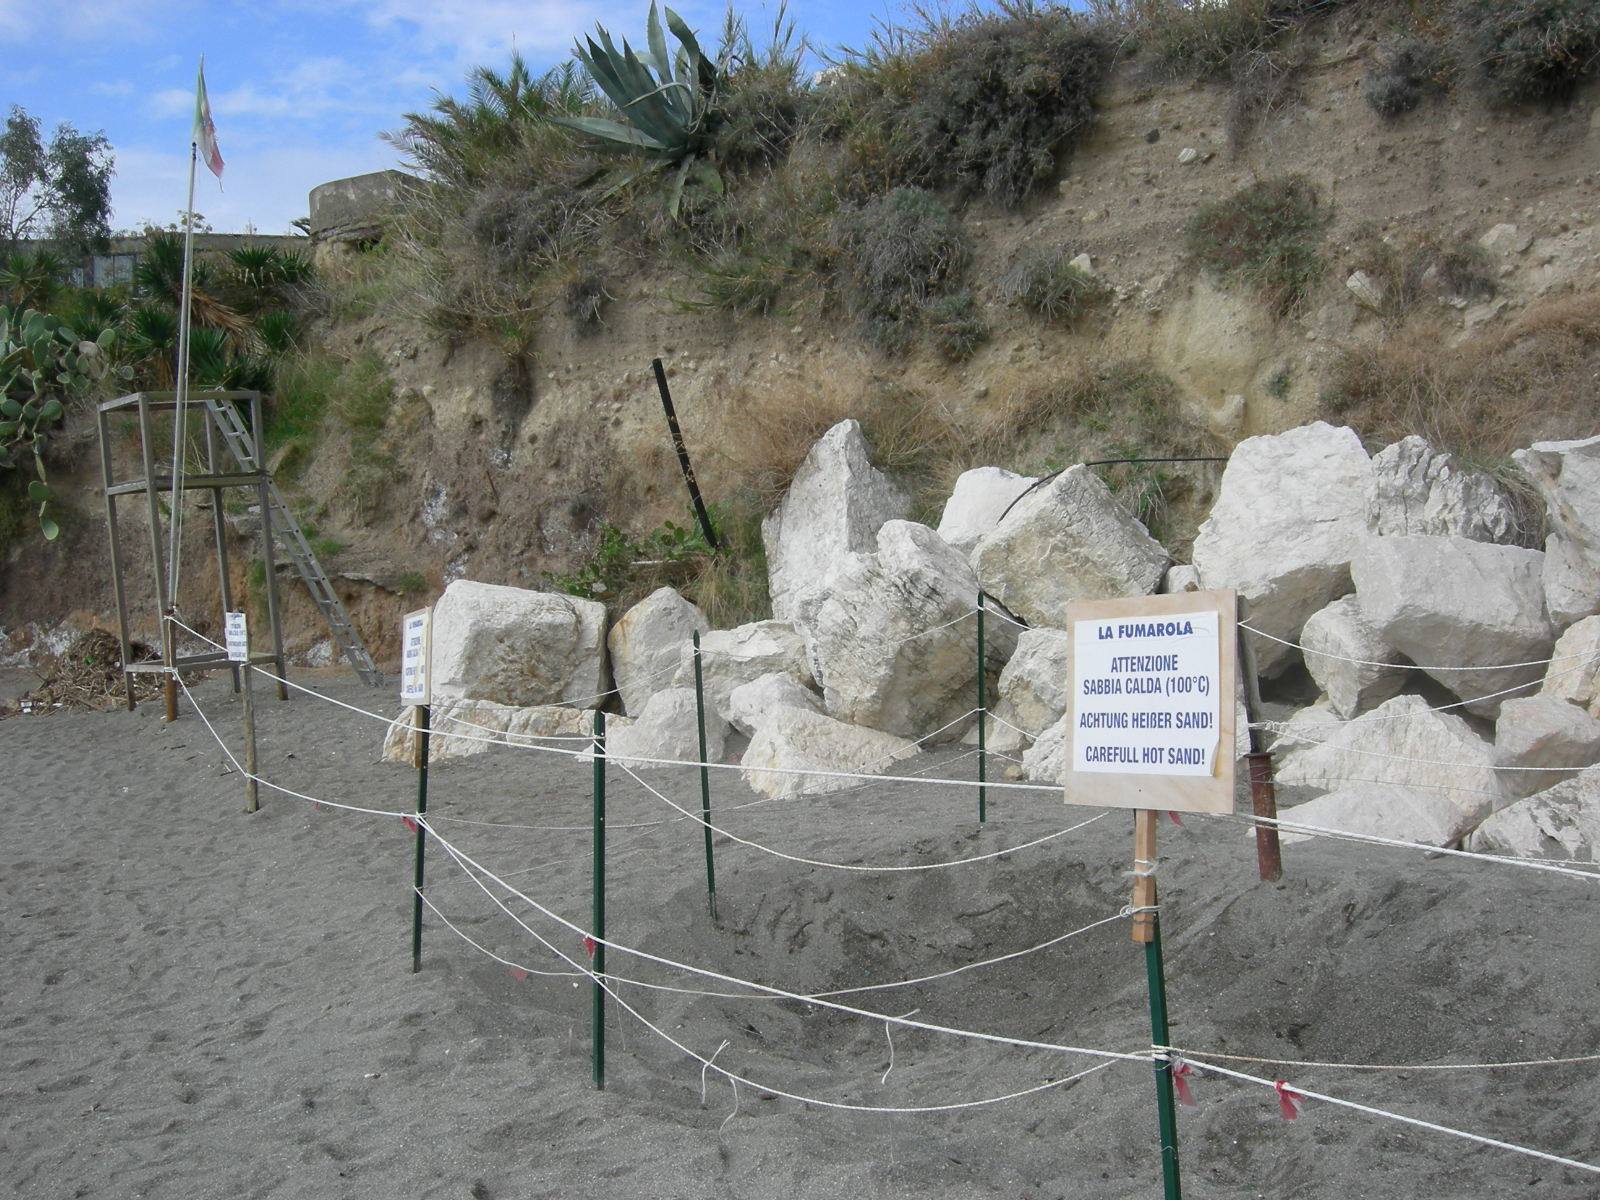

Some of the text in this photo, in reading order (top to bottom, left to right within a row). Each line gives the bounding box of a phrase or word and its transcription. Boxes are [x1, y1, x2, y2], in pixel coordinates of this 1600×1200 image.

[1098, 621, 1193, 640] LA FUMAROLA
[1111, 654, 1178, 673] ATTENZIONE
[1083, 675, 1210, 697] SABBIA CALDA (100°C)
[1080, 712, 1128, 729] ACHTUNG
[1176, 712, 1213, 729] SAND!
[1085, 746, 1205, 765] CAREFULL HOT SAND!
